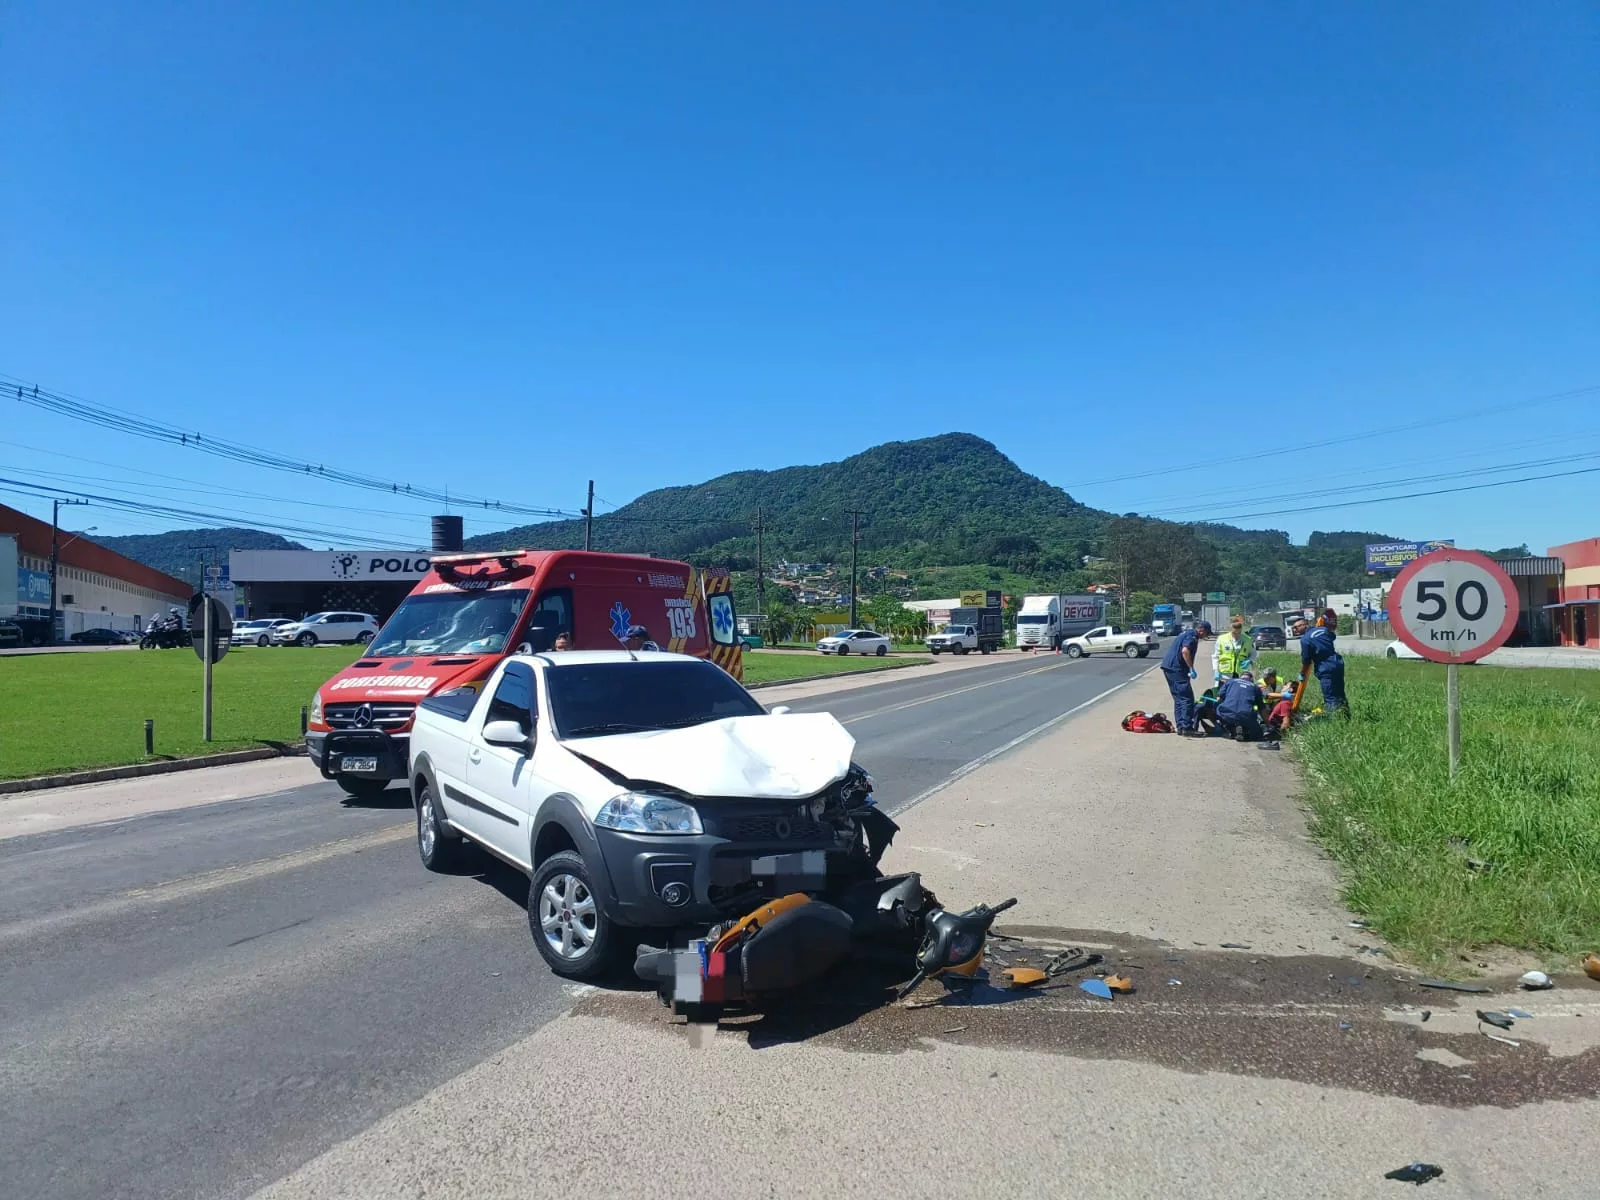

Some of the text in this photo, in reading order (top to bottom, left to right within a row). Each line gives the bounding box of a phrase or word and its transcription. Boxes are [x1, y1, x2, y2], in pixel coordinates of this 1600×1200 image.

[1370, 553, 1418, 562] EXCLUSIVOS
[369, 558, 431, 573] POLO
[1416, 580, 1489, 622] 50
[666, 608, 696, 639] 193
[1430, 628, 1477, 641] km/h
